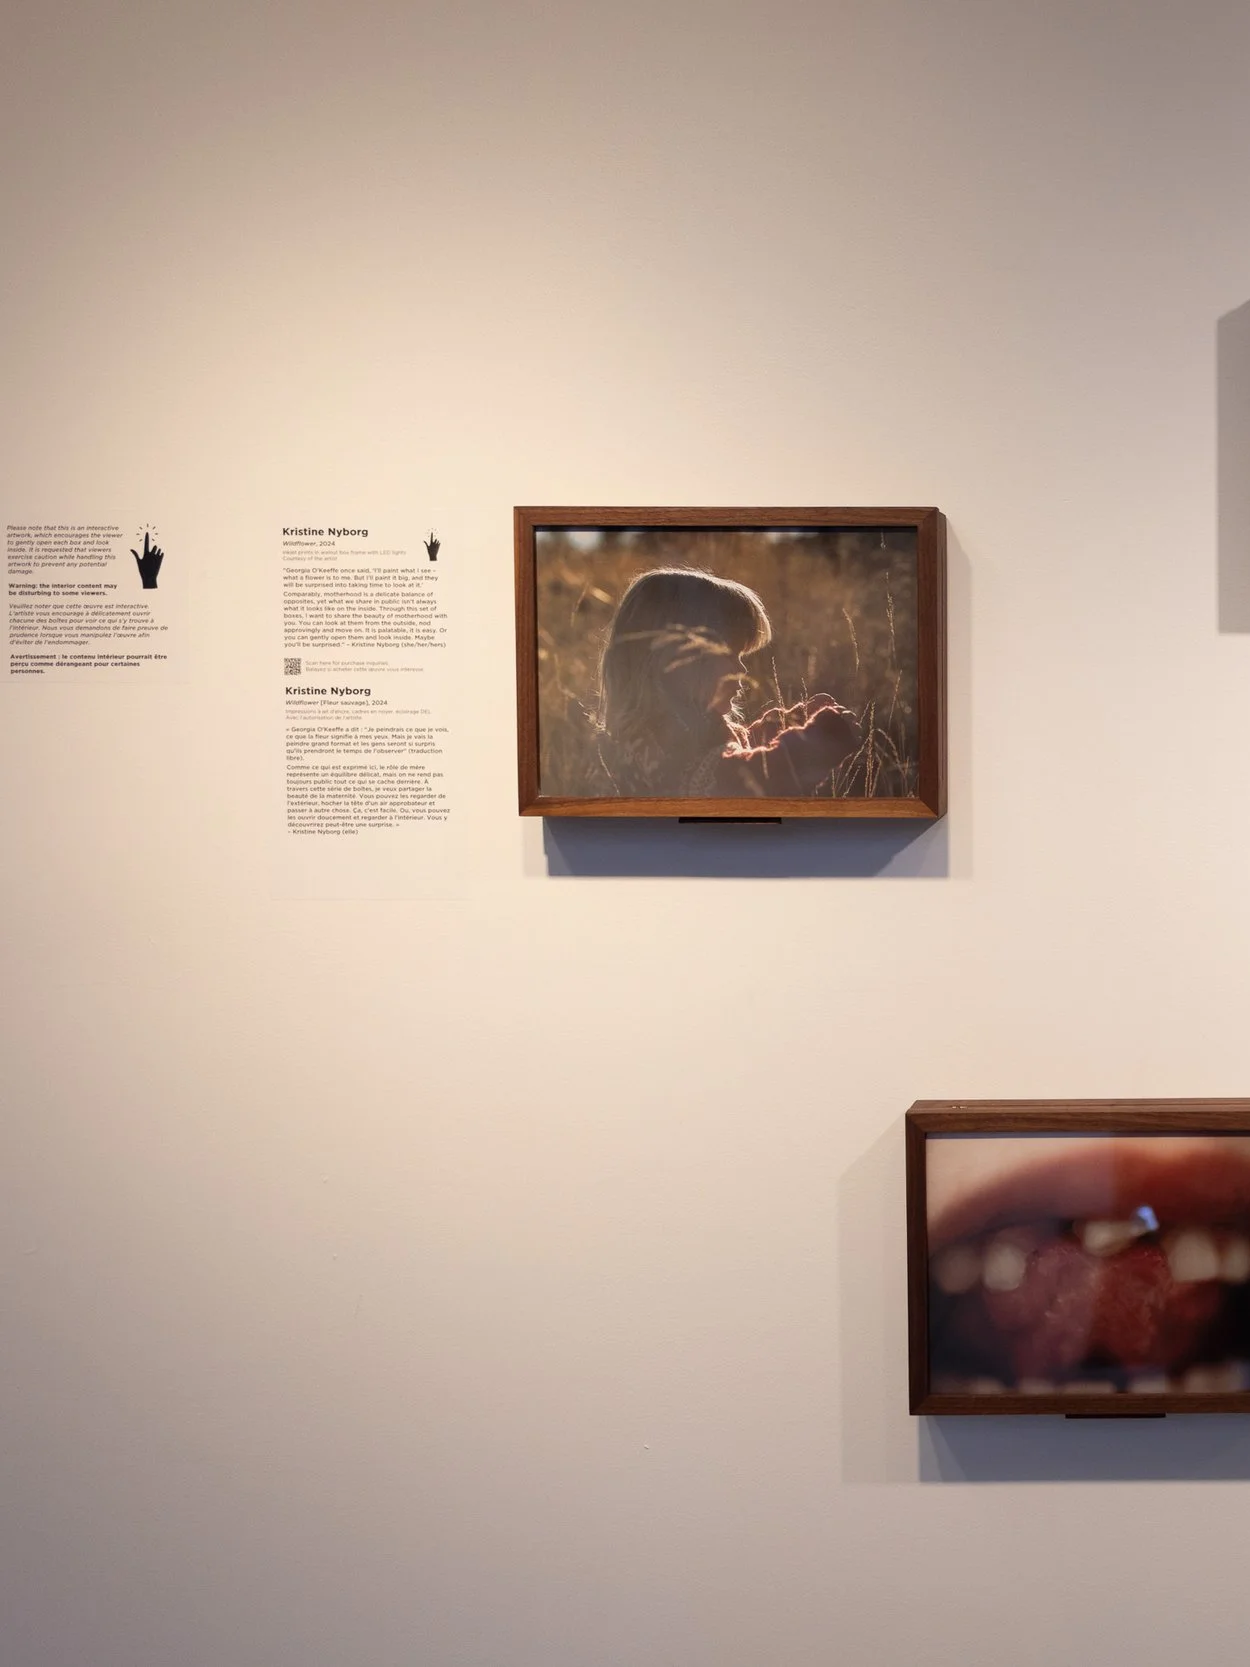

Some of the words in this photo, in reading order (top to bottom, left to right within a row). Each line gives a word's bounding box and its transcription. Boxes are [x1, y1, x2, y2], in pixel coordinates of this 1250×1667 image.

[283, 528, 324, 536] Kristine
[328, 528, 368, 537] Nyborg
[286, 687, 327, 695] Kristine
[331, 687, 371, 696] Nyborg
